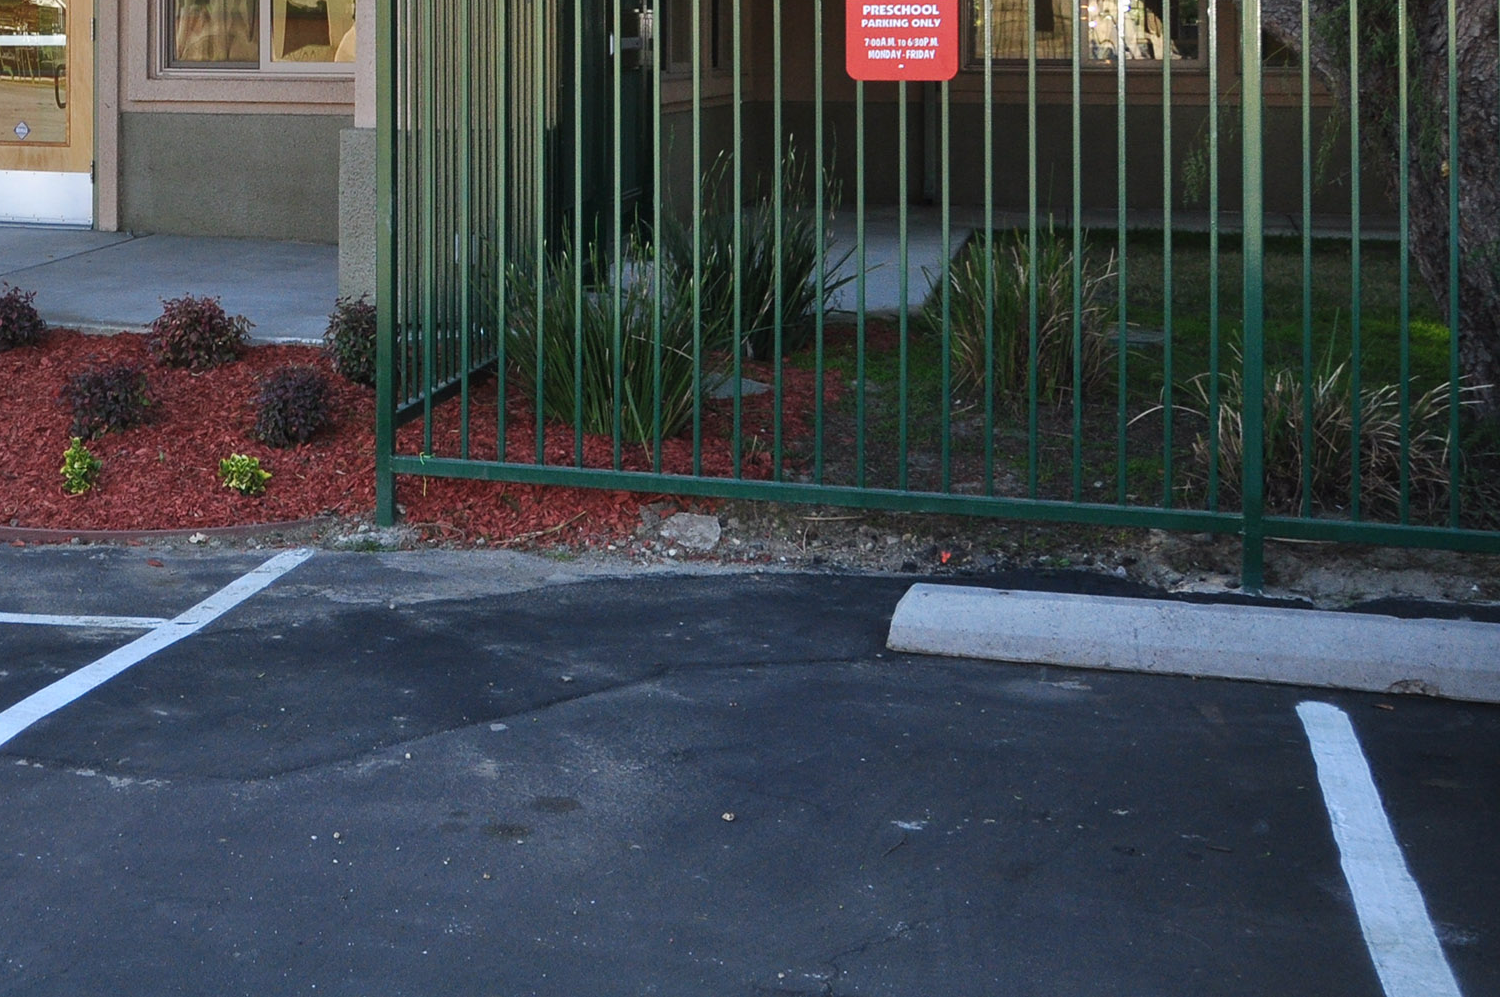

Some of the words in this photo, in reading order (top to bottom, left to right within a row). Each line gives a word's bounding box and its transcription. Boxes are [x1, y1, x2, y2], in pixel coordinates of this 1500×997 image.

[862, 4, 939, 15] PRESCHOOL
[861, 18, 909, 28] PARKING
[911, 18, 941, 28] ONLY
